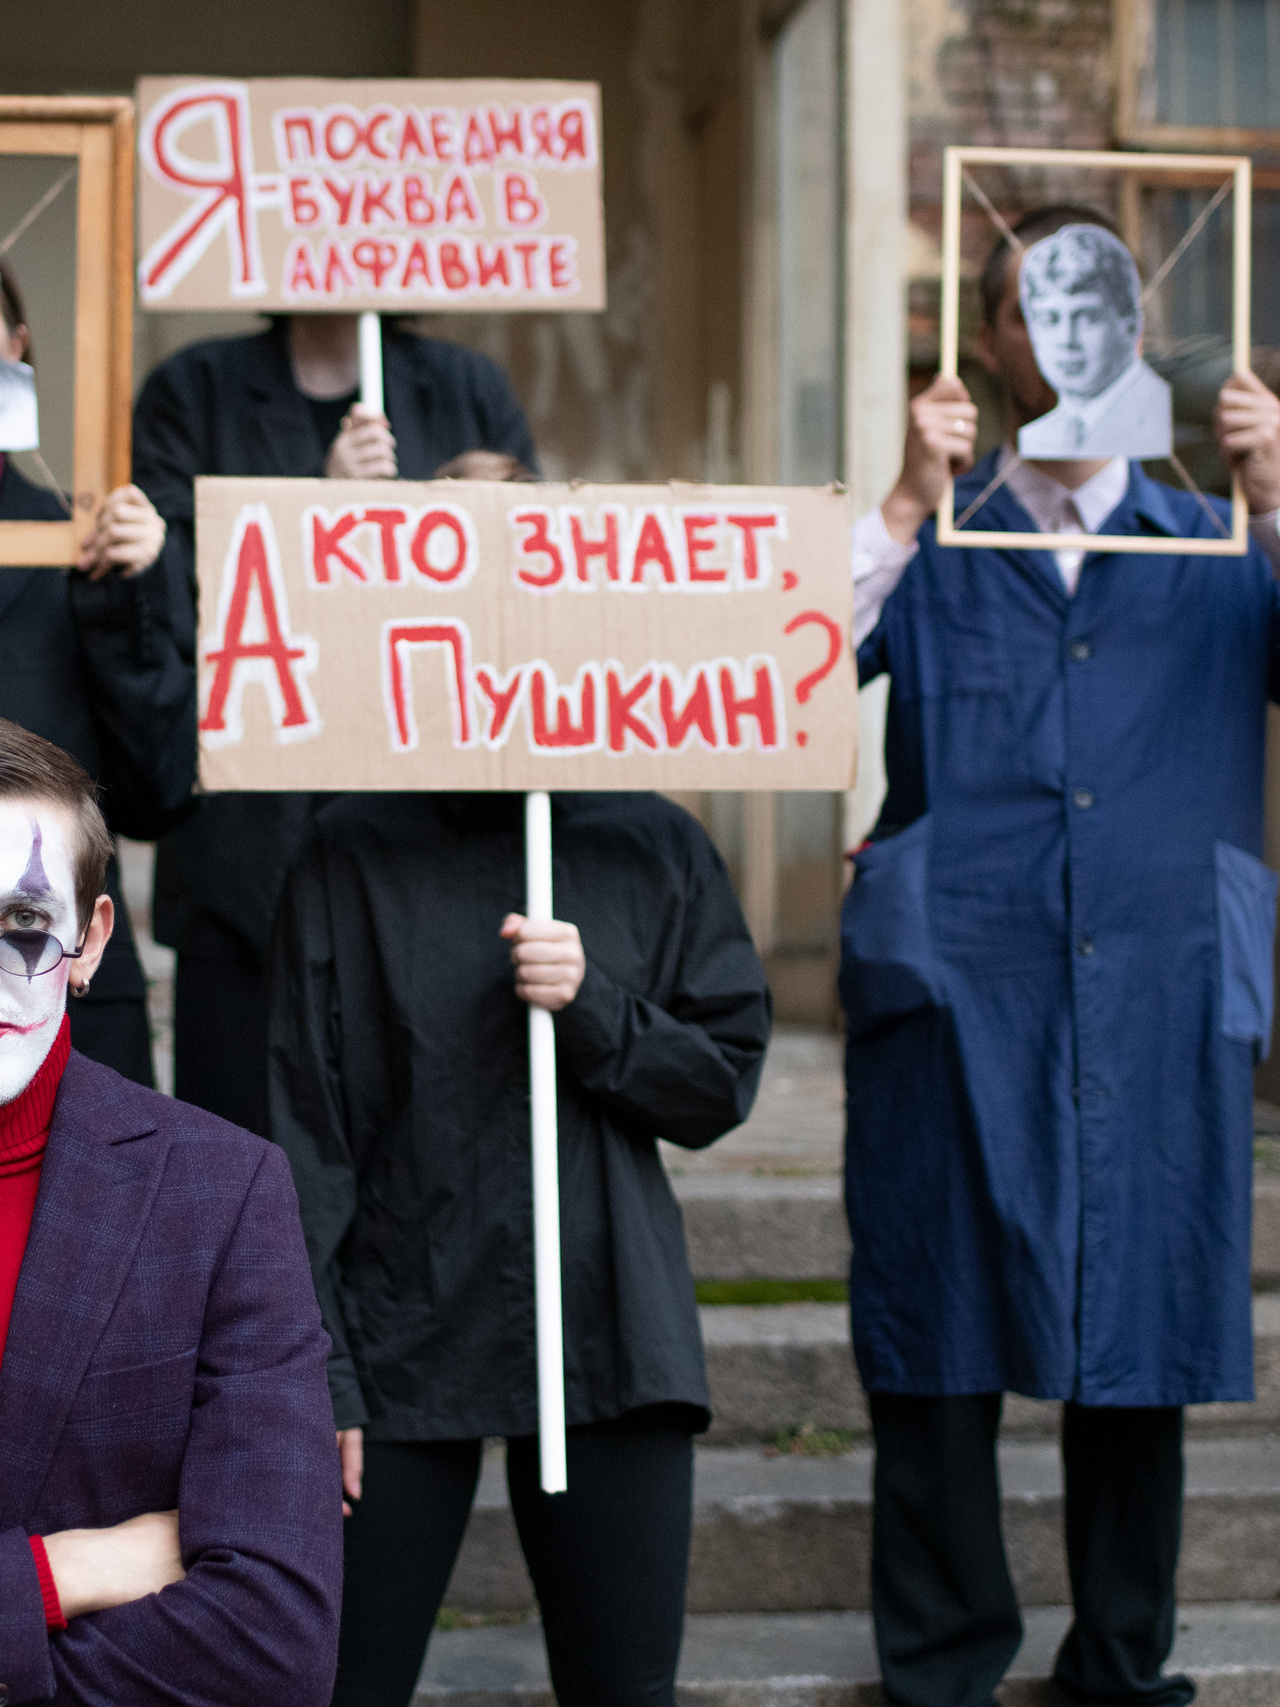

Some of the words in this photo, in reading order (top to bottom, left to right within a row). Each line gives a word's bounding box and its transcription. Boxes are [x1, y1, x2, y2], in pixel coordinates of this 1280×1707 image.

[282, 109, 589, 167] ПОСЛЕДНЯЯ
[288, 175, 478, 227] БУКВА
[502, 174, 543, 226] В
[290, 238, 573, 293] АЛФАВИТЕ
[197, 520, 311, 733] А
[310, 508, 470, 585] КТО
[514, 511, 801, 593] ЗНАЕТ,
